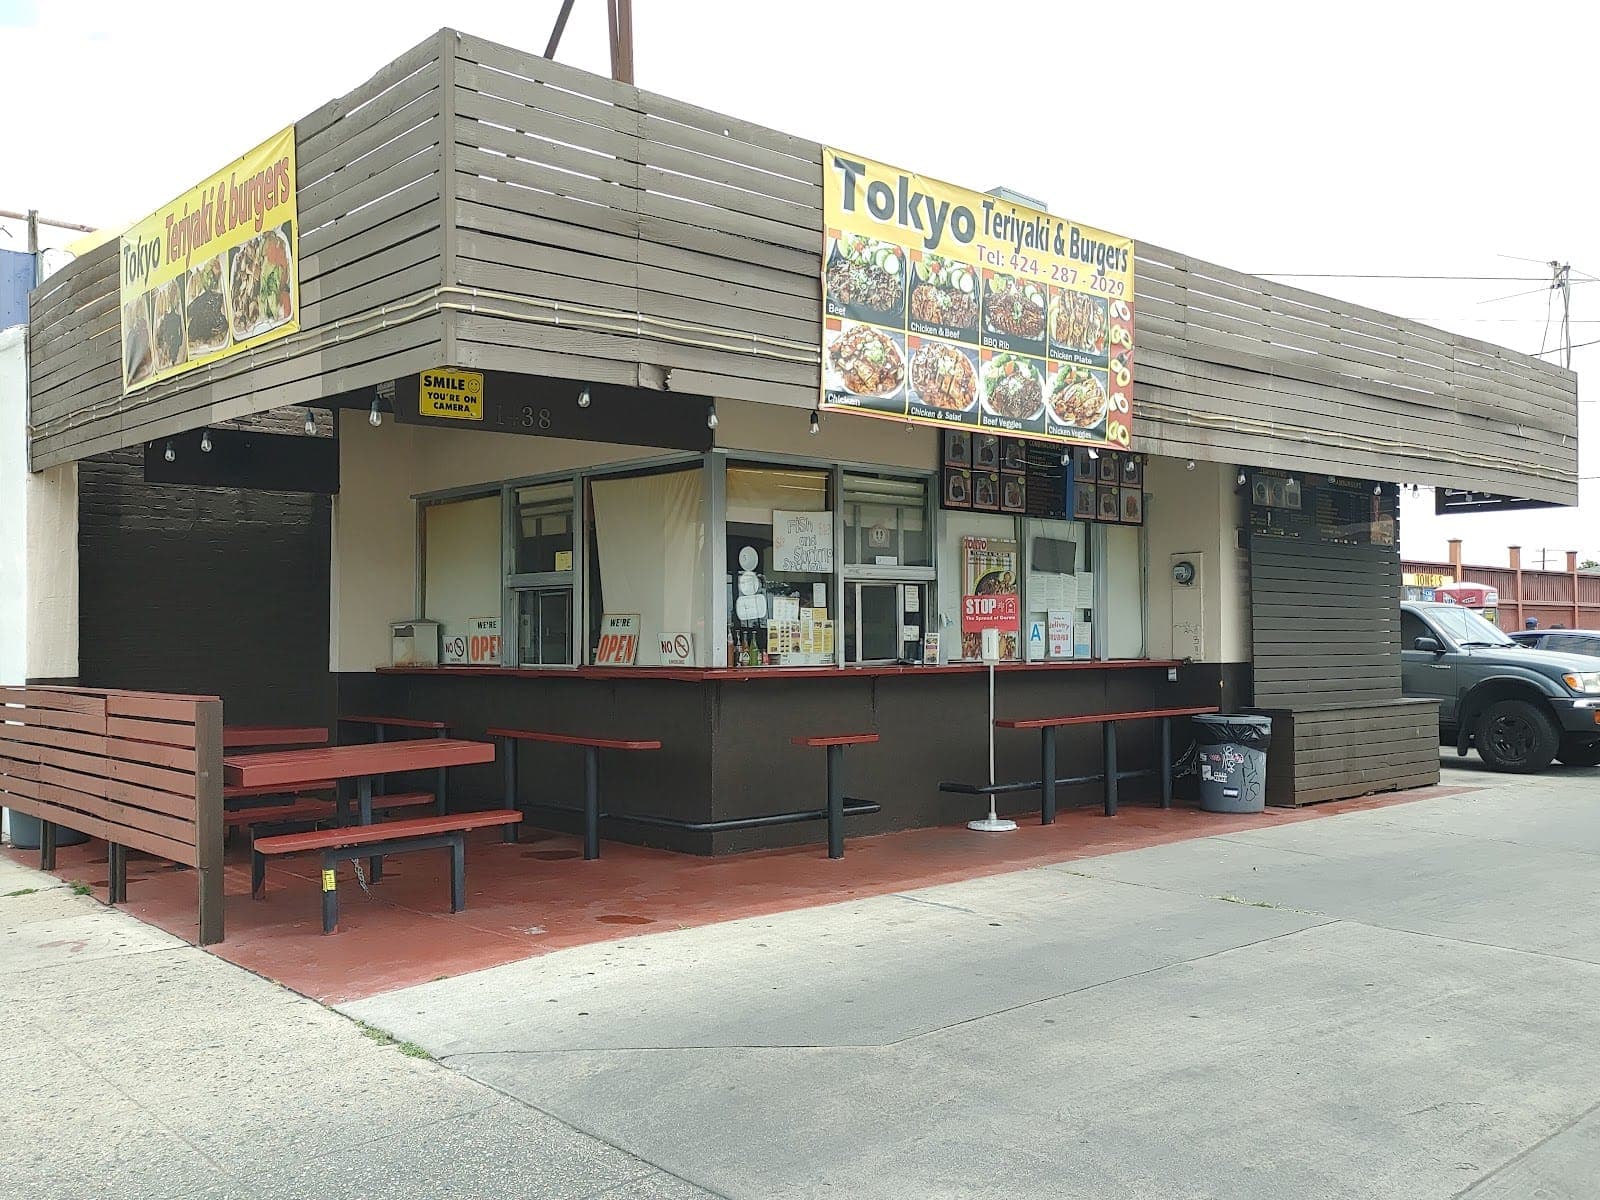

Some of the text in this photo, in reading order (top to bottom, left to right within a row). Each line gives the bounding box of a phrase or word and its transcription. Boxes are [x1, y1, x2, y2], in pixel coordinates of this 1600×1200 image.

[123, 156, 290, 287] Tokyo Teriyaki & burgers
[833, 155, 1129, 276] Tokyo Teriyaki & Burgers
[976, 244, 1005, 266] Tel:
[1010, 256, 1038, 275] 424
[1051, 264, 1077, 284] 287
[1089, 274, 1126, 297] 2029
[828, 303, 846, 316] Beef
[911, 322, 937, 335] Chicken
[944, 327, 960, 340] Beef
[983, 336, 1010, 351] BBQ Rib
[1049, 350, 1093, 365] Chicken Plate
[423, 375, 466, 391] SMILE
[427, 391, 477, 404] YOU'RE ON
[828, 393, 860, 407] Chicken
[433, 402, 470, 412] CAMERA
[911, 406, 935, 418] Chicken
[945, 410, 961, 421] Salad
[983, 416, 1022, 431] Beef Veggies
[1048, 426, 1091, 439] Chicken Veggies
[965, 598, 997, 614] STOP
[477, 621, 497, 629] WE'RE
[610, 618, 631, 627] WE'RE
[1030, 623, 1041, 641] A
[445, 642, 454, 654] NO
[598, 634, 636, 663] OPEN
[661, 640, 673, 654] NO
